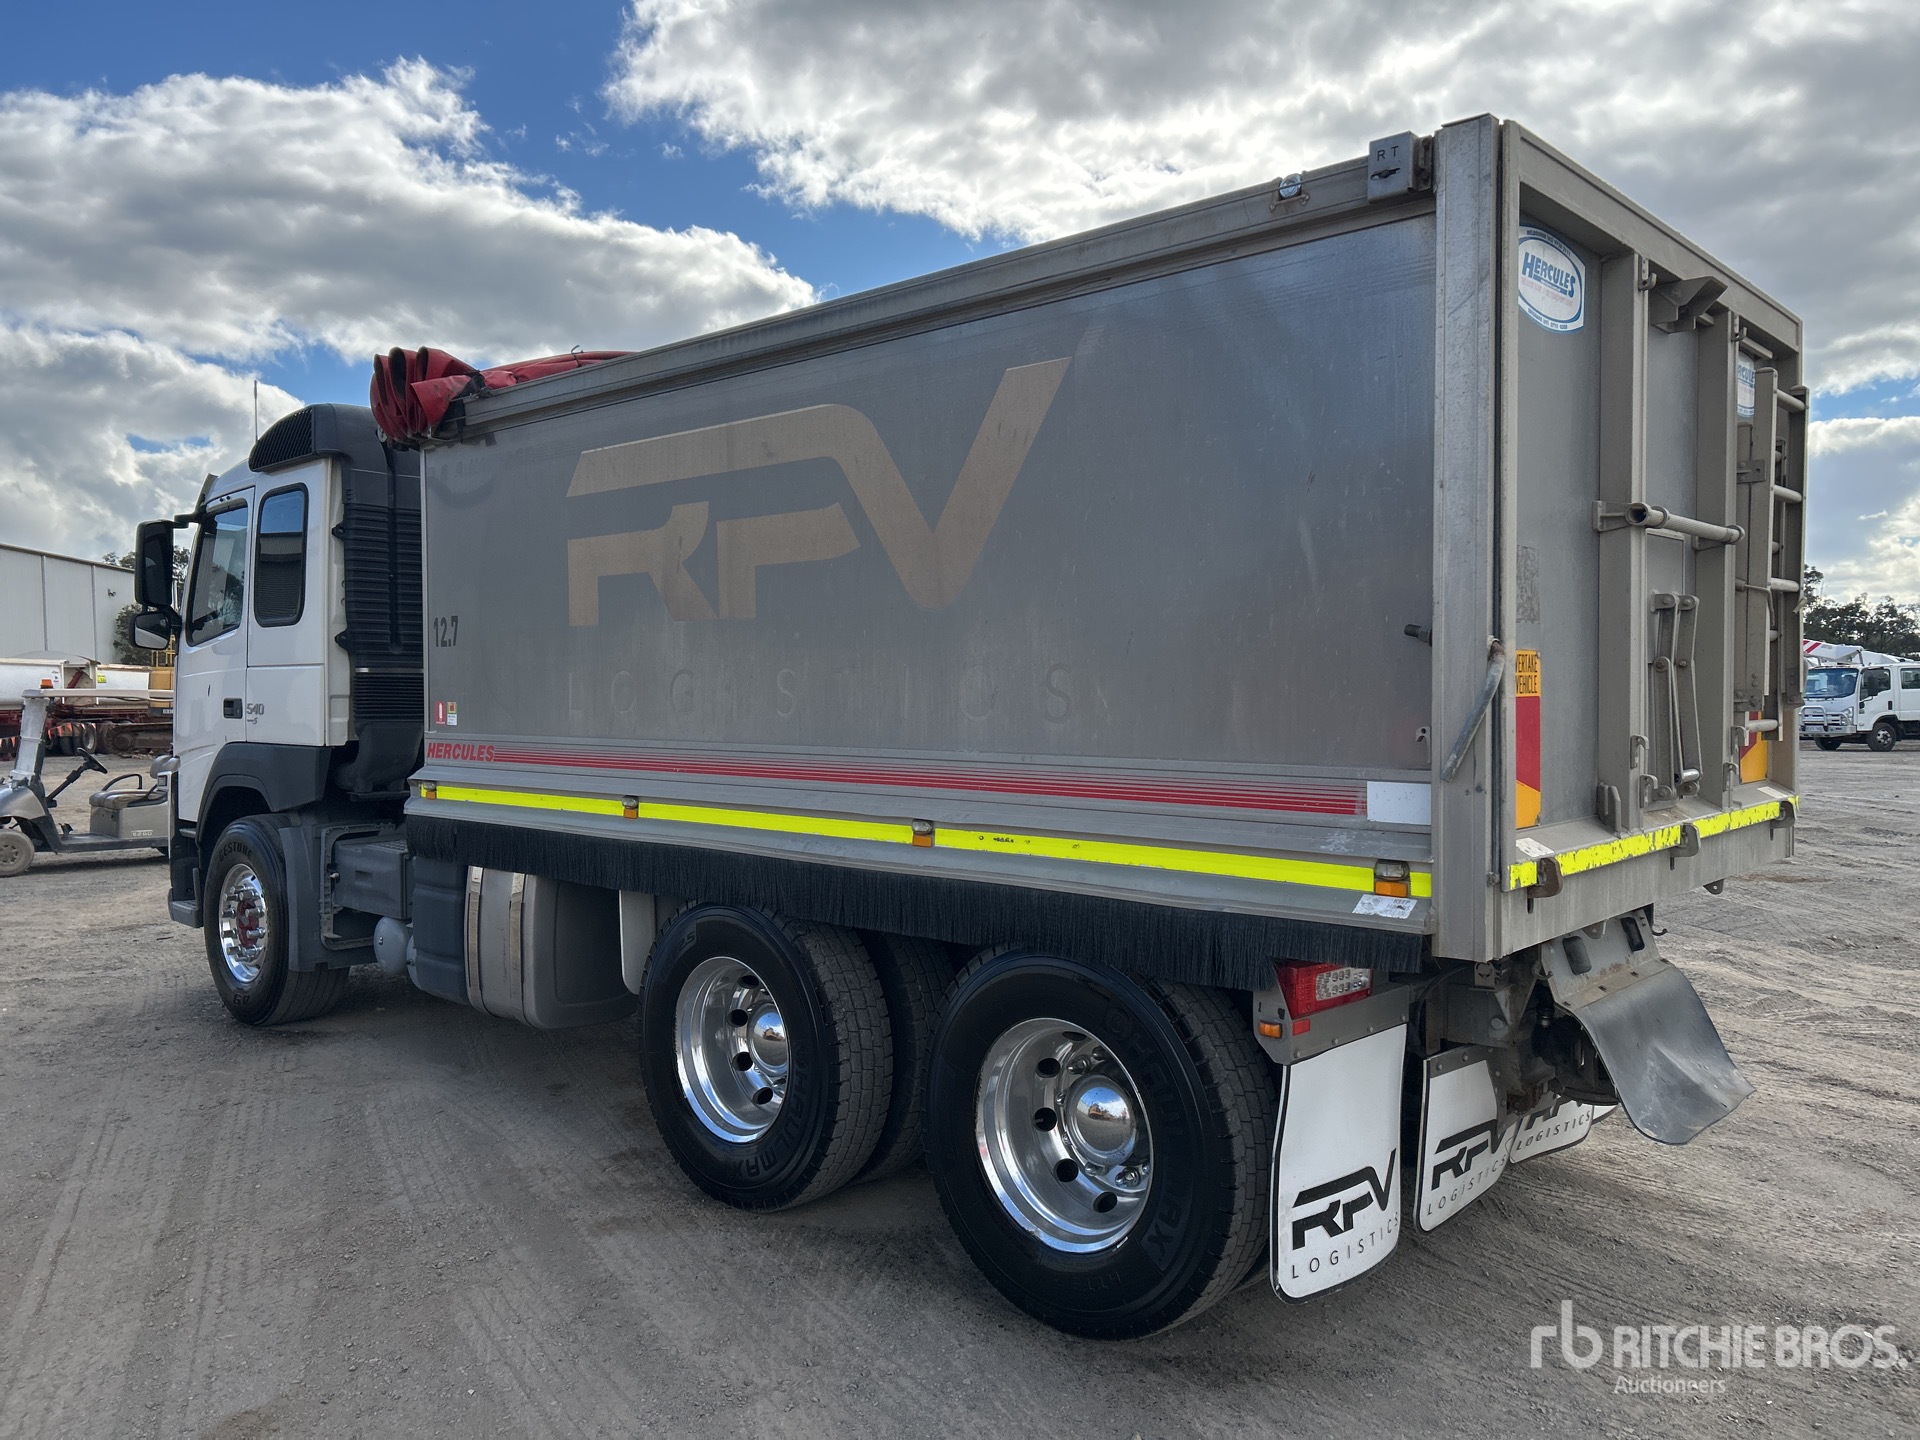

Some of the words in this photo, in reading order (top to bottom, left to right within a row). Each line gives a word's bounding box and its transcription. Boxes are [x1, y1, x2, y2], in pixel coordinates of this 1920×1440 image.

[1522, 252, 1576, 298] HERCULES
[566, 356, 1073, 626] RPV
[433, 615, 459, 648] 12.7
[246, 703, 265, 716] 540
[427, 742, 495, 762] HERCULES
[1516, 1110, 1591, 1151] LOGISTICS
[1292, 1147, 1397, 1250] RPV
[1427, 1154, 1507, 1216] LOGISTICS
[1292, 1210, 1399, 1279] LOGISTICS
